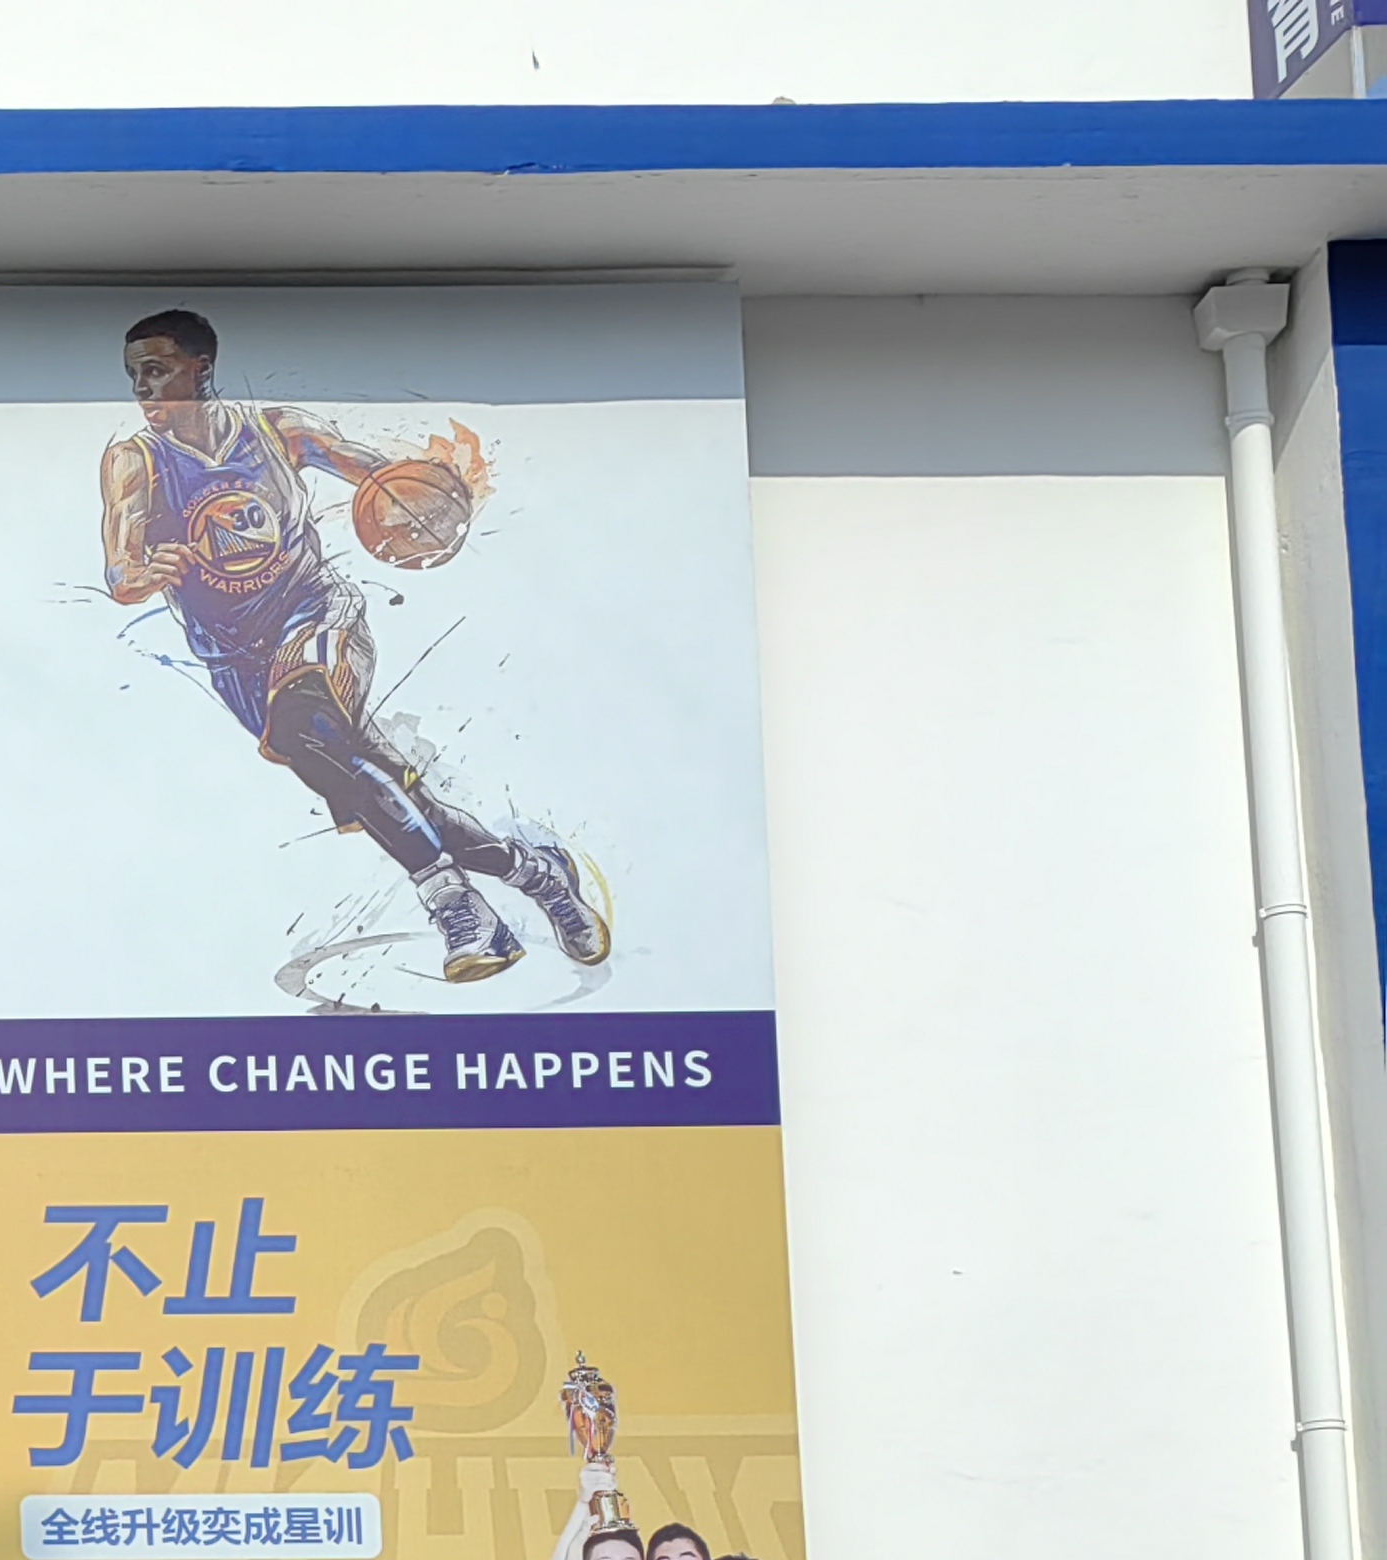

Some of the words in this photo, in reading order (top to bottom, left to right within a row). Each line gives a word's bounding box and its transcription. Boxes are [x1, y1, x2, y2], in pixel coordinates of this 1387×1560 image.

[230, 502, 266, 532] 30
[199, 551, 291, 594] WARRIORS
[209, 1053, 431, 1092] CHANGE
[456, 1049, 713, 1090] HAPPENS
[30, 1196, 298, 1323] 不止
[12, 1342, 421, 1471] 于训练
[39, 1505, 366, 1548] 全线升级奕成星训
